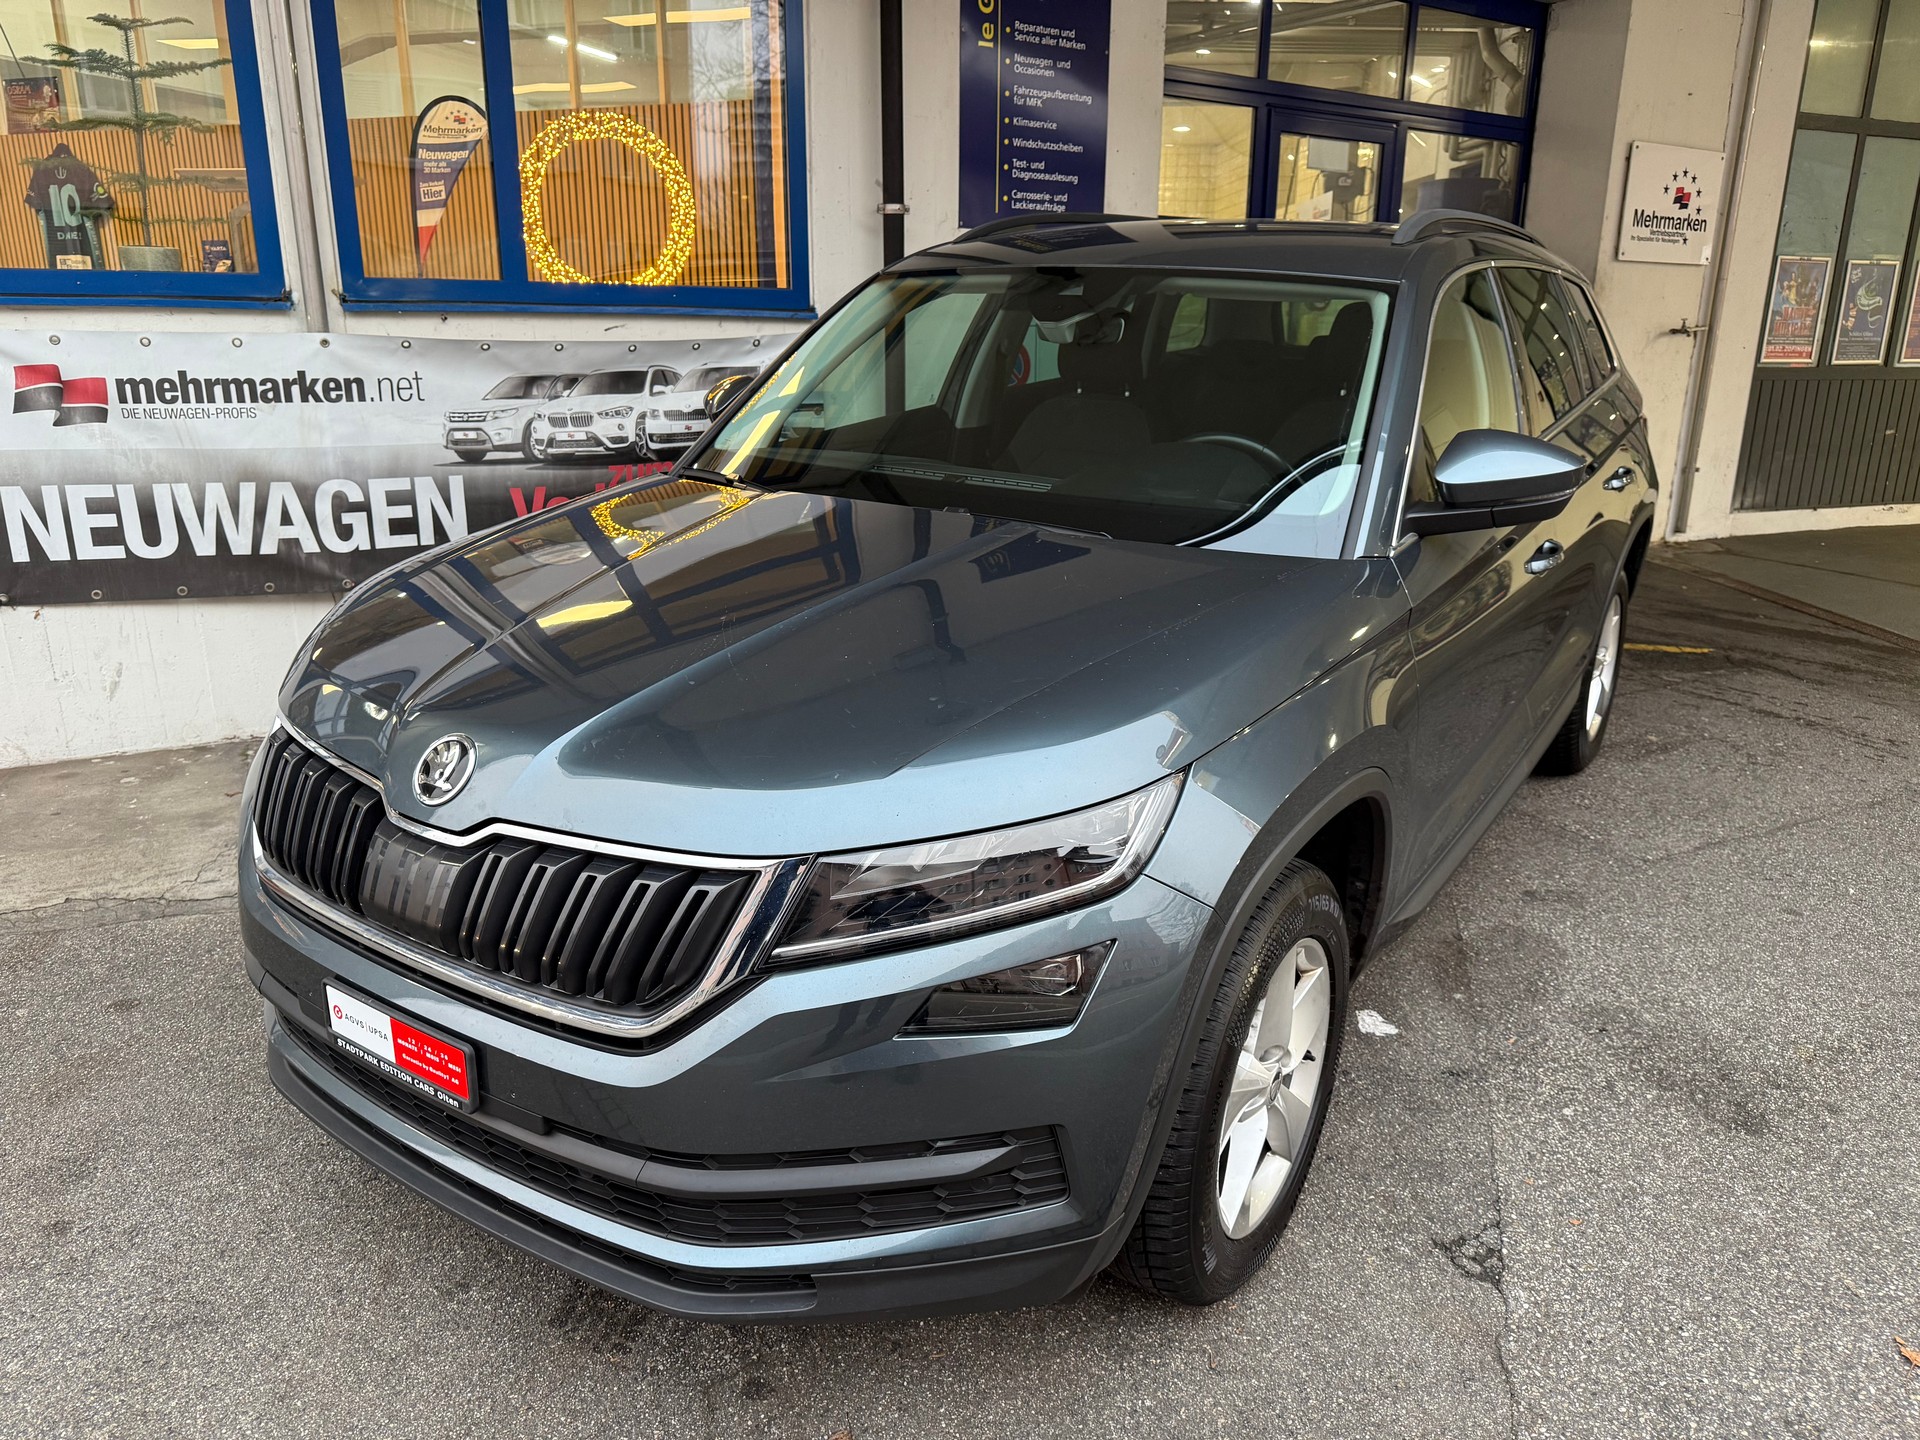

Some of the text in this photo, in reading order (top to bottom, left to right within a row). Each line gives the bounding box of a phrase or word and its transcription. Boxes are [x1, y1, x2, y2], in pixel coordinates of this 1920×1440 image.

[1014, 20, 1076, 38] Reparaturen und
[1014, 31, 1087, 50] Service aller Marken
[1014, 53, 1071, 69] Neuwagen und
[1014, 64, 1055, 77] Occasionen
[1013, 85, 1092, 105] Fahrzeugaufbereitung
[1013, 95, 1043, 107] für MFK
[423, 125, 482, 134] Mehrmarken
[1012, 117, 1058, 130] Klimaservice
[1012, 138, 1084, 153] Windschutzscheiben
[418, 148, 469, 161] Neuwagen
[1012, 158, 1045, 170] Test- und
[1011, 169, 1079, 185] Diagnoseauslesung
[422, 188, 443, 200] Hier
[1011, 189, 1068, 202] Carrosserie- und
[48, 184, 82, 227] 10
[1011, 200, 1066, 213] Lackieraufträge
[1632, 208, 1707, 232] Mehrmarken
[115, 370, 425, 405] mehrmarken.net
[121, 407, 257, 419] DIE NEUWAGEN-PROFIS
[0, 475, 469, 562] NEUWAGEN
[337, 1037, 460, 1109] STADTPARK EDITION CARS Olten
